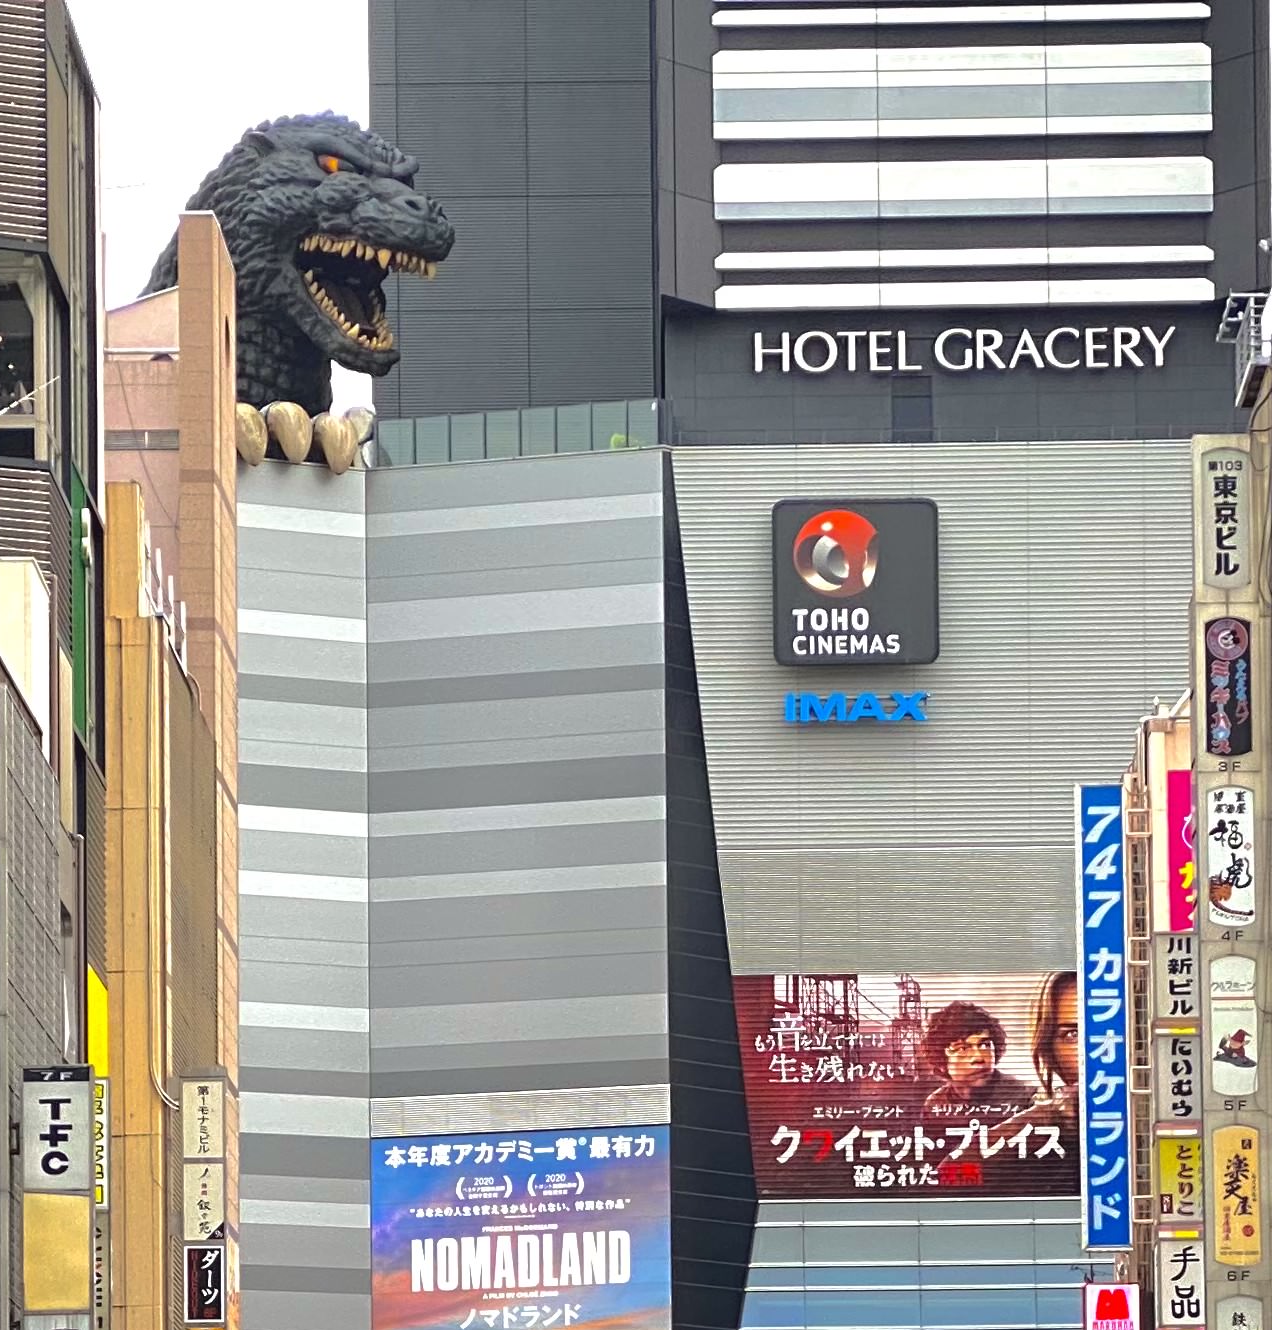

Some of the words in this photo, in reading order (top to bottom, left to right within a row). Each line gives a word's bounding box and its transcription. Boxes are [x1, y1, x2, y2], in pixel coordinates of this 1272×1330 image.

[753, 329, 923, 373] HOTEL
[934, 325, 1177, 371] GRACERY
[1212, 474, 1241, 577] 東京ビル
[791, 607, 871, 632] TOHO
[791, 633, 901, 656] CINEMAS
[783, 691, 929, 724] IMAX
[1217, 761, 1242, 772] 3F
[1220, 930, 1244, 941] 4F
[1166, 936, 1193, 1017] 川新ビル
[39, 1071, 74, 1082] 7F
[767, 1053, 907, 1085] 生き残れない
[1170, 1037, 1193, 1117] にいむら
[1087, 946, 1127, 1231] カラオケランド
[812, 1105, 906, 1120] エミリー・ブラント
[1223, 1100, 1247, 1112] 5F
[38, 1097, 73, 1176] TFC
[769, 1119, 1067, 1165] クワイエット・プレイス
[473, 1176, 495, 1187] 2020
[545, 1173, 567, 1184] 2020
[199, 1249, 220, 1306] ダーツ
[410, 1229, 632, 1294] NOMADLAND
[1227, 1270, 1251, 1282] 6F
[1169, 1245, 1201, 1320] 手品
[459, 1303, 583, 1330] ノマドランド
